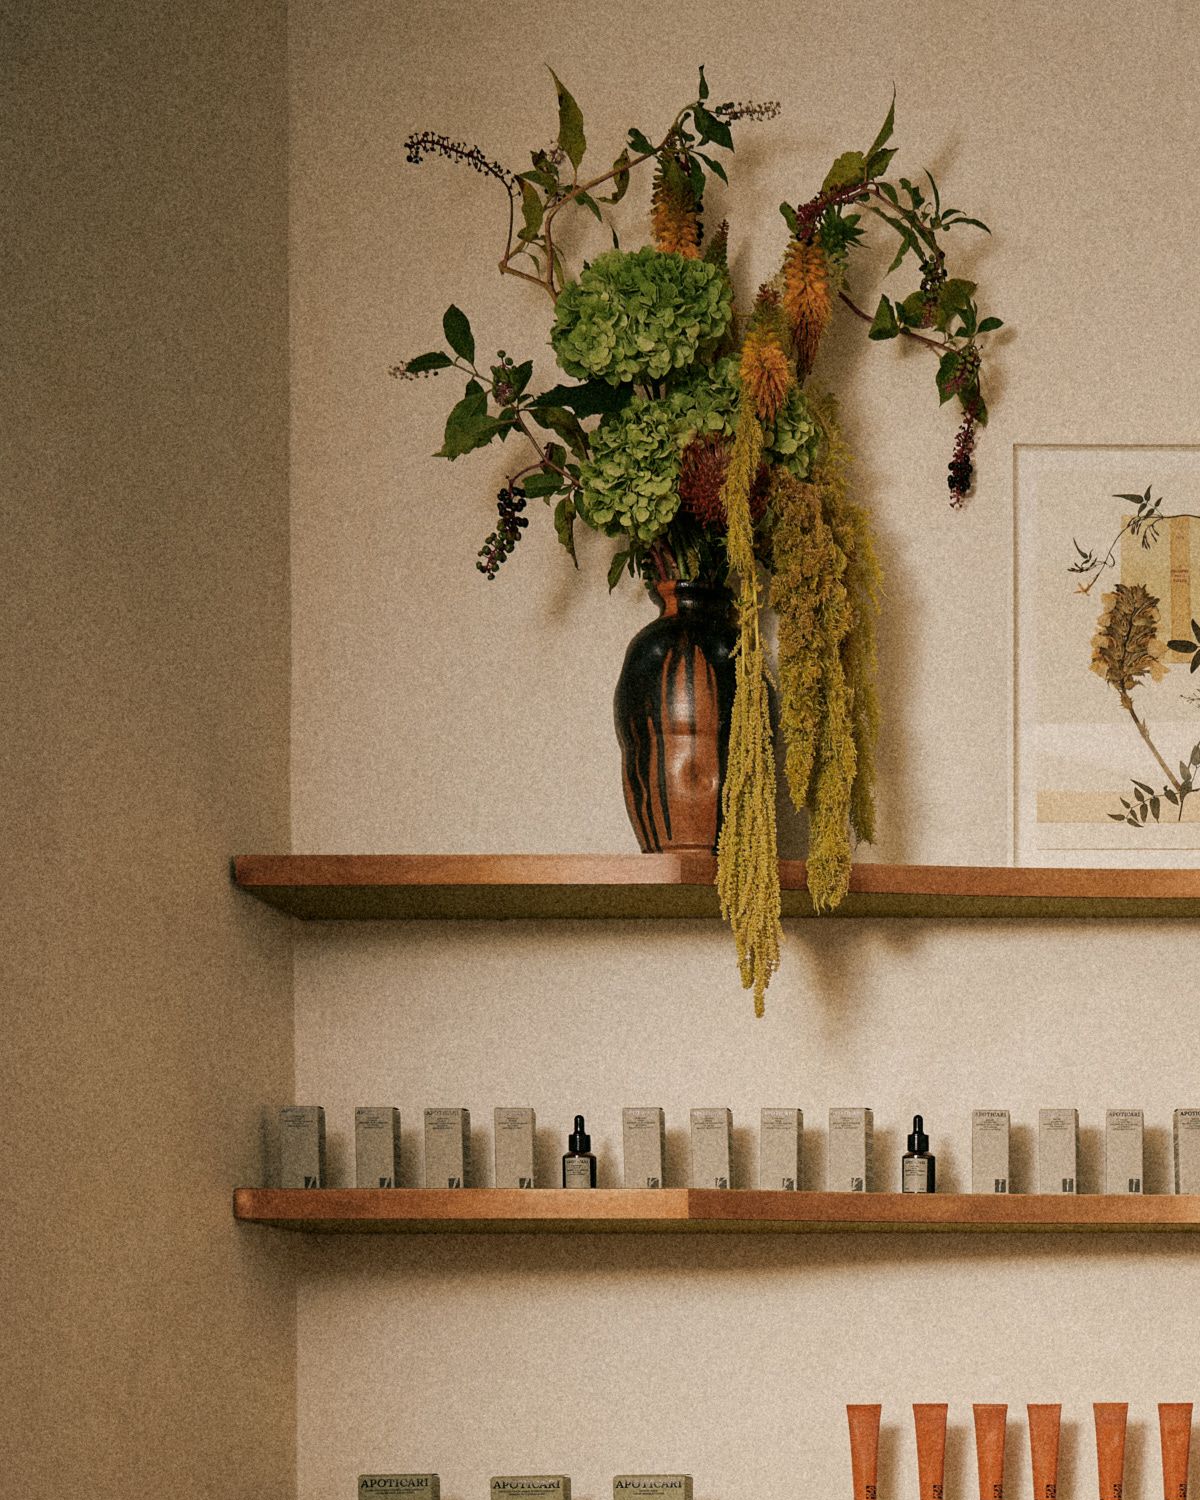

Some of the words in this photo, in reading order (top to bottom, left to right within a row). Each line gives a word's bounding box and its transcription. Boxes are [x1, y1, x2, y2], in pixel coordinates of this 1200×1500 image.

[361, 1478, 429, 1488] APOTICARI
[493, 1480, 560, 1489] APOTICARI
[615, 1480, 682, 1489] APOTICARI
